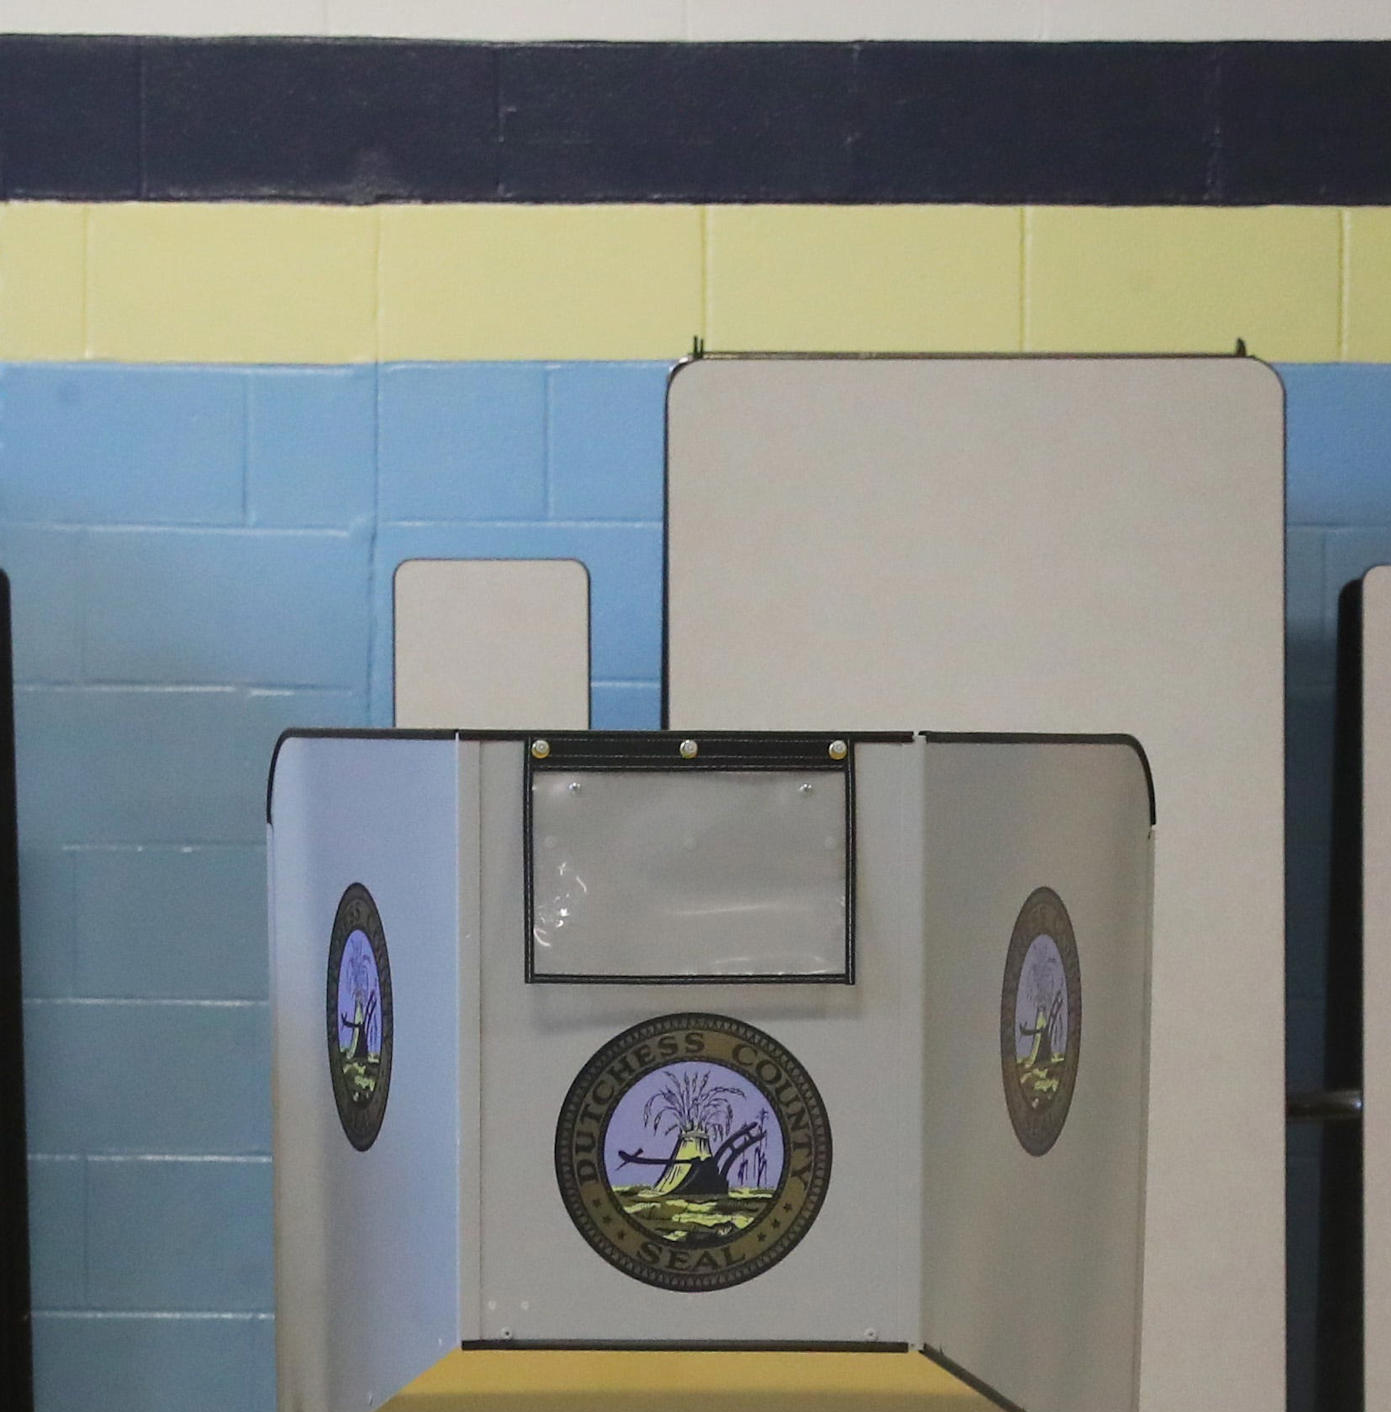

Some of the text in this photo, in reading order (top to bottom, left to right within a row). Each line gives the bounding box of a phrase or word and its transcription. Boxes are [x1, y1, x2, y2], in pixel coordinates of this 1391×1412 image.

[575, 1032, 810, 1191] DUTCHESS COUNTY
[637, 1242, 747, 1272] SEAL
